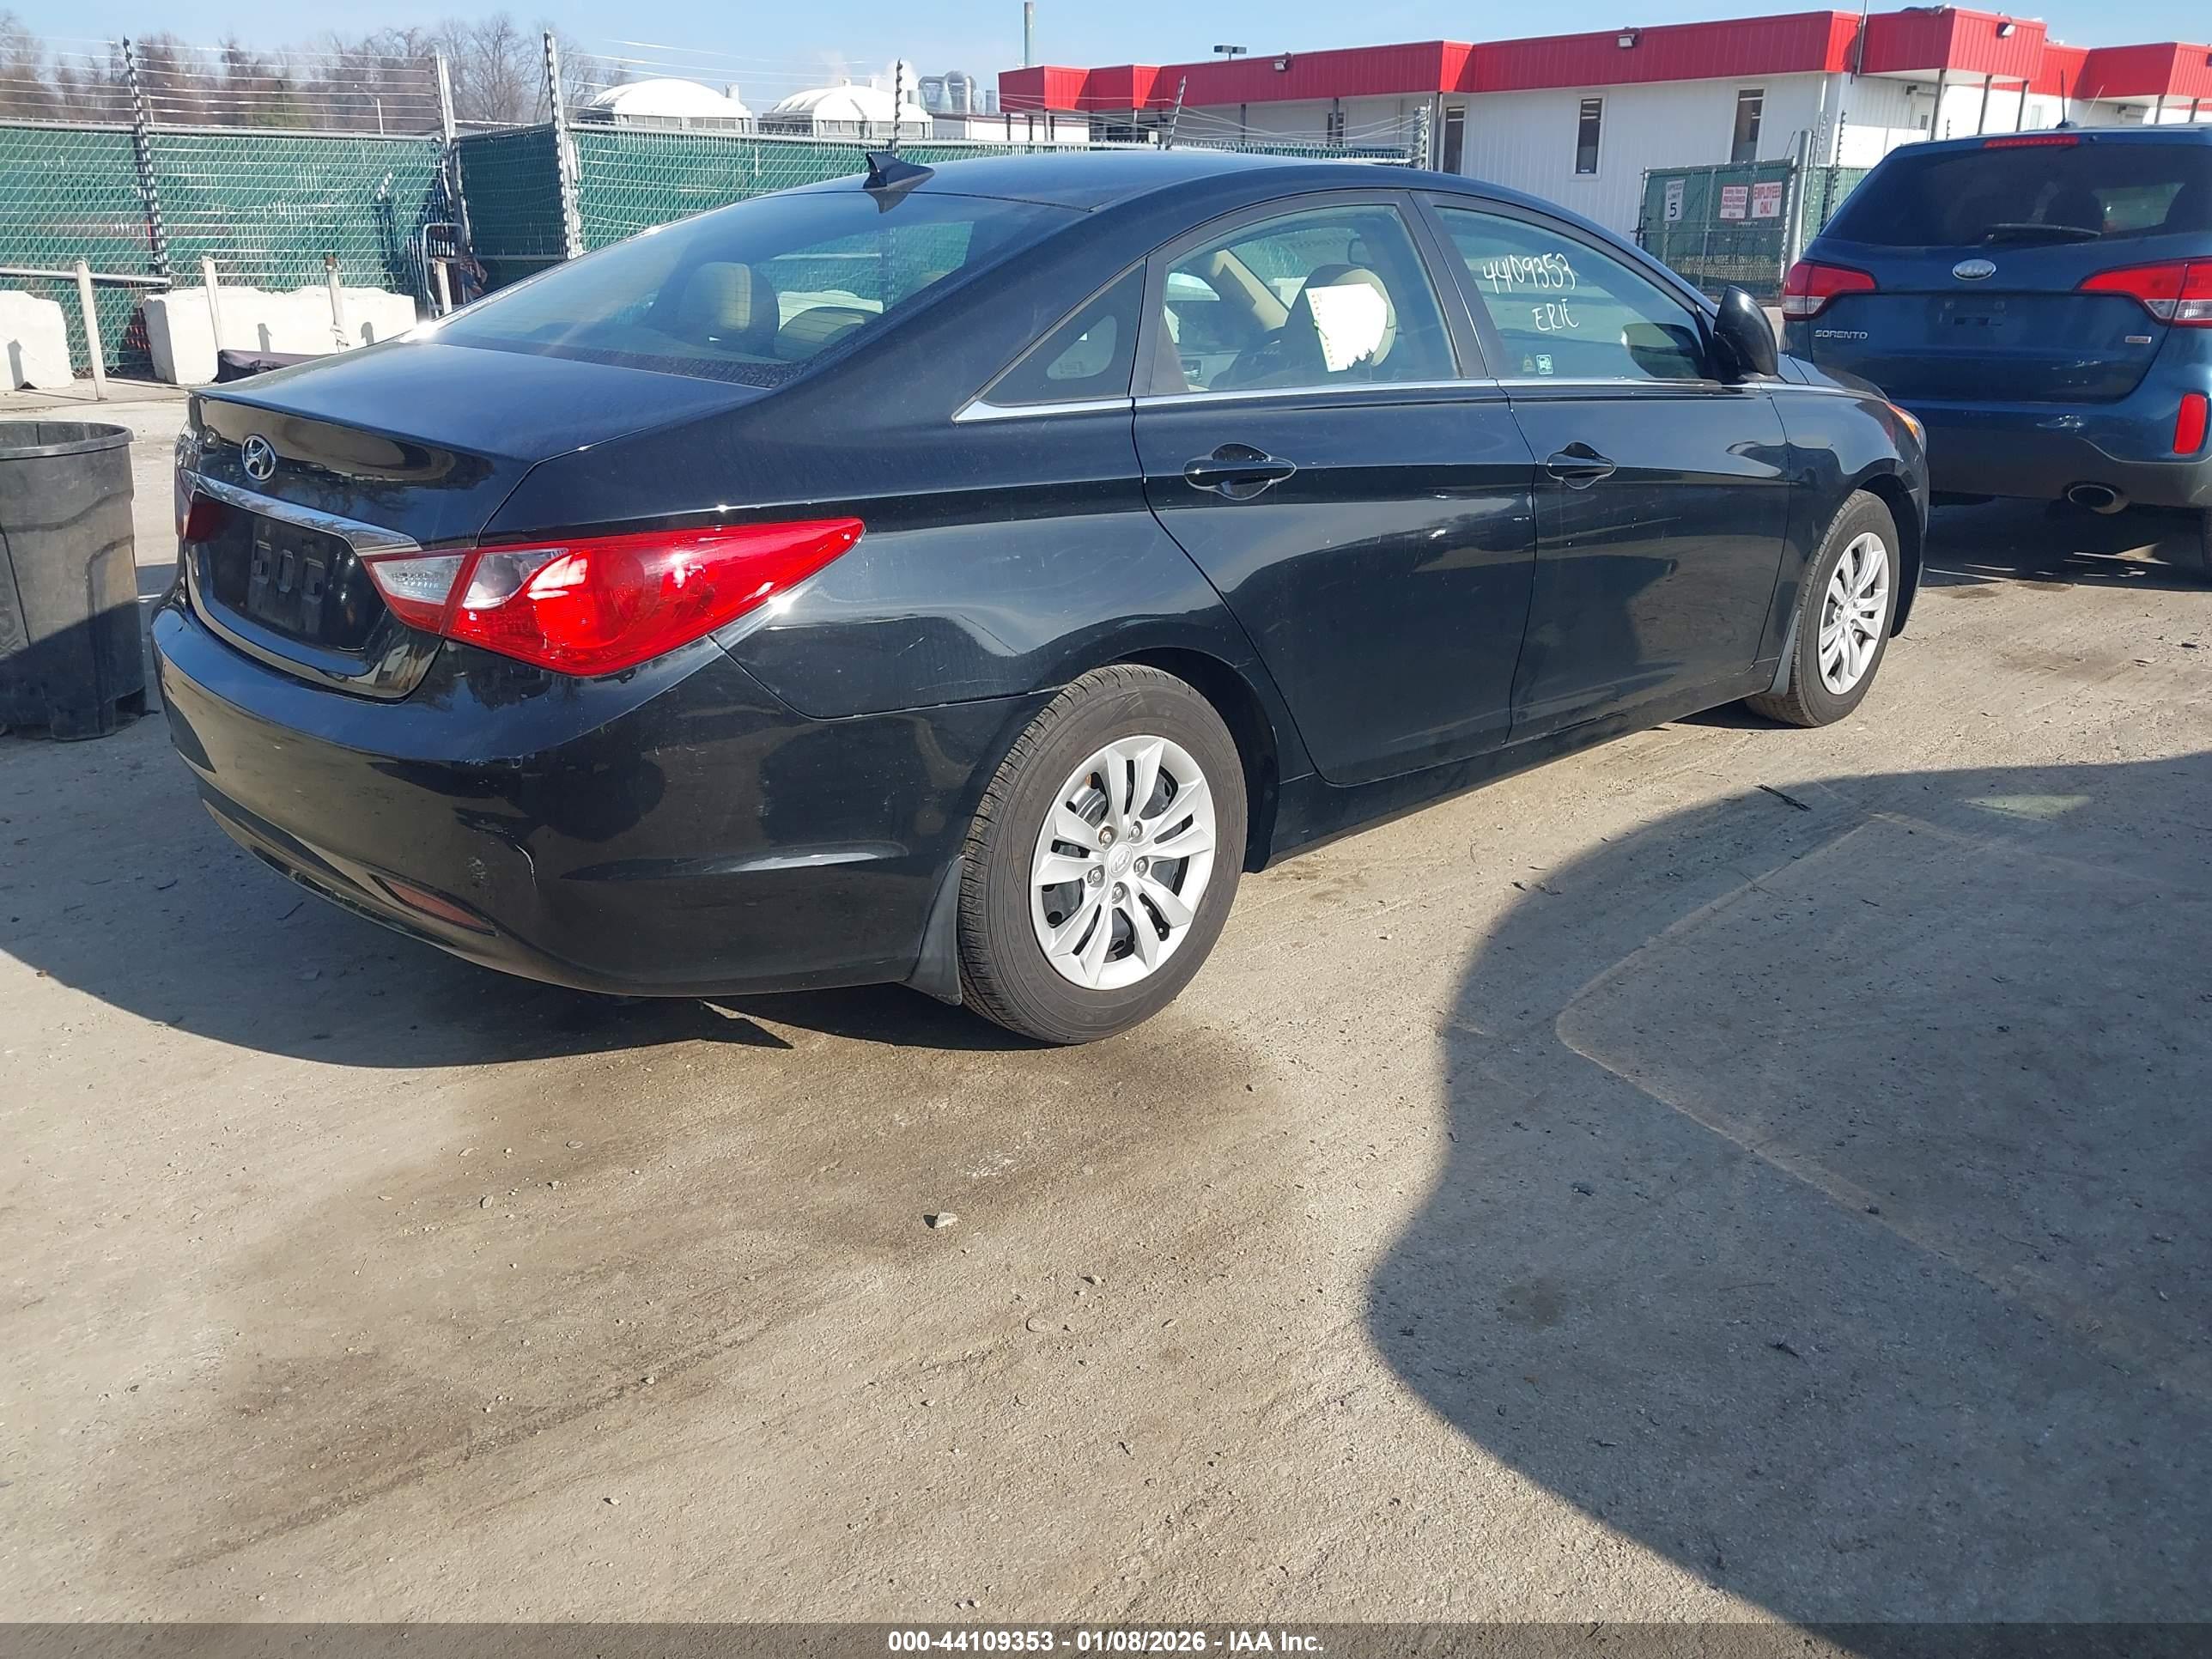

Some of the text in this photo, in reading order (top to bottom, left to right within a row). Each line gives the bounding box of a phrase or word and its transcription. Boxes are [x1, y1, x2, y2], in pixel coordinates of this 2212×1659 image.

[1668, 191, 1680, 200] LIMIT
[1753, 185, 1781, 200] EMPLOYEES
[1669, 202, 1677, 217] 5
[1759, 201, 1772, 214] ONLY
[1483, 252, 1576, 295] 44109353
[1814, 330, 1869, 339] SORENTO
